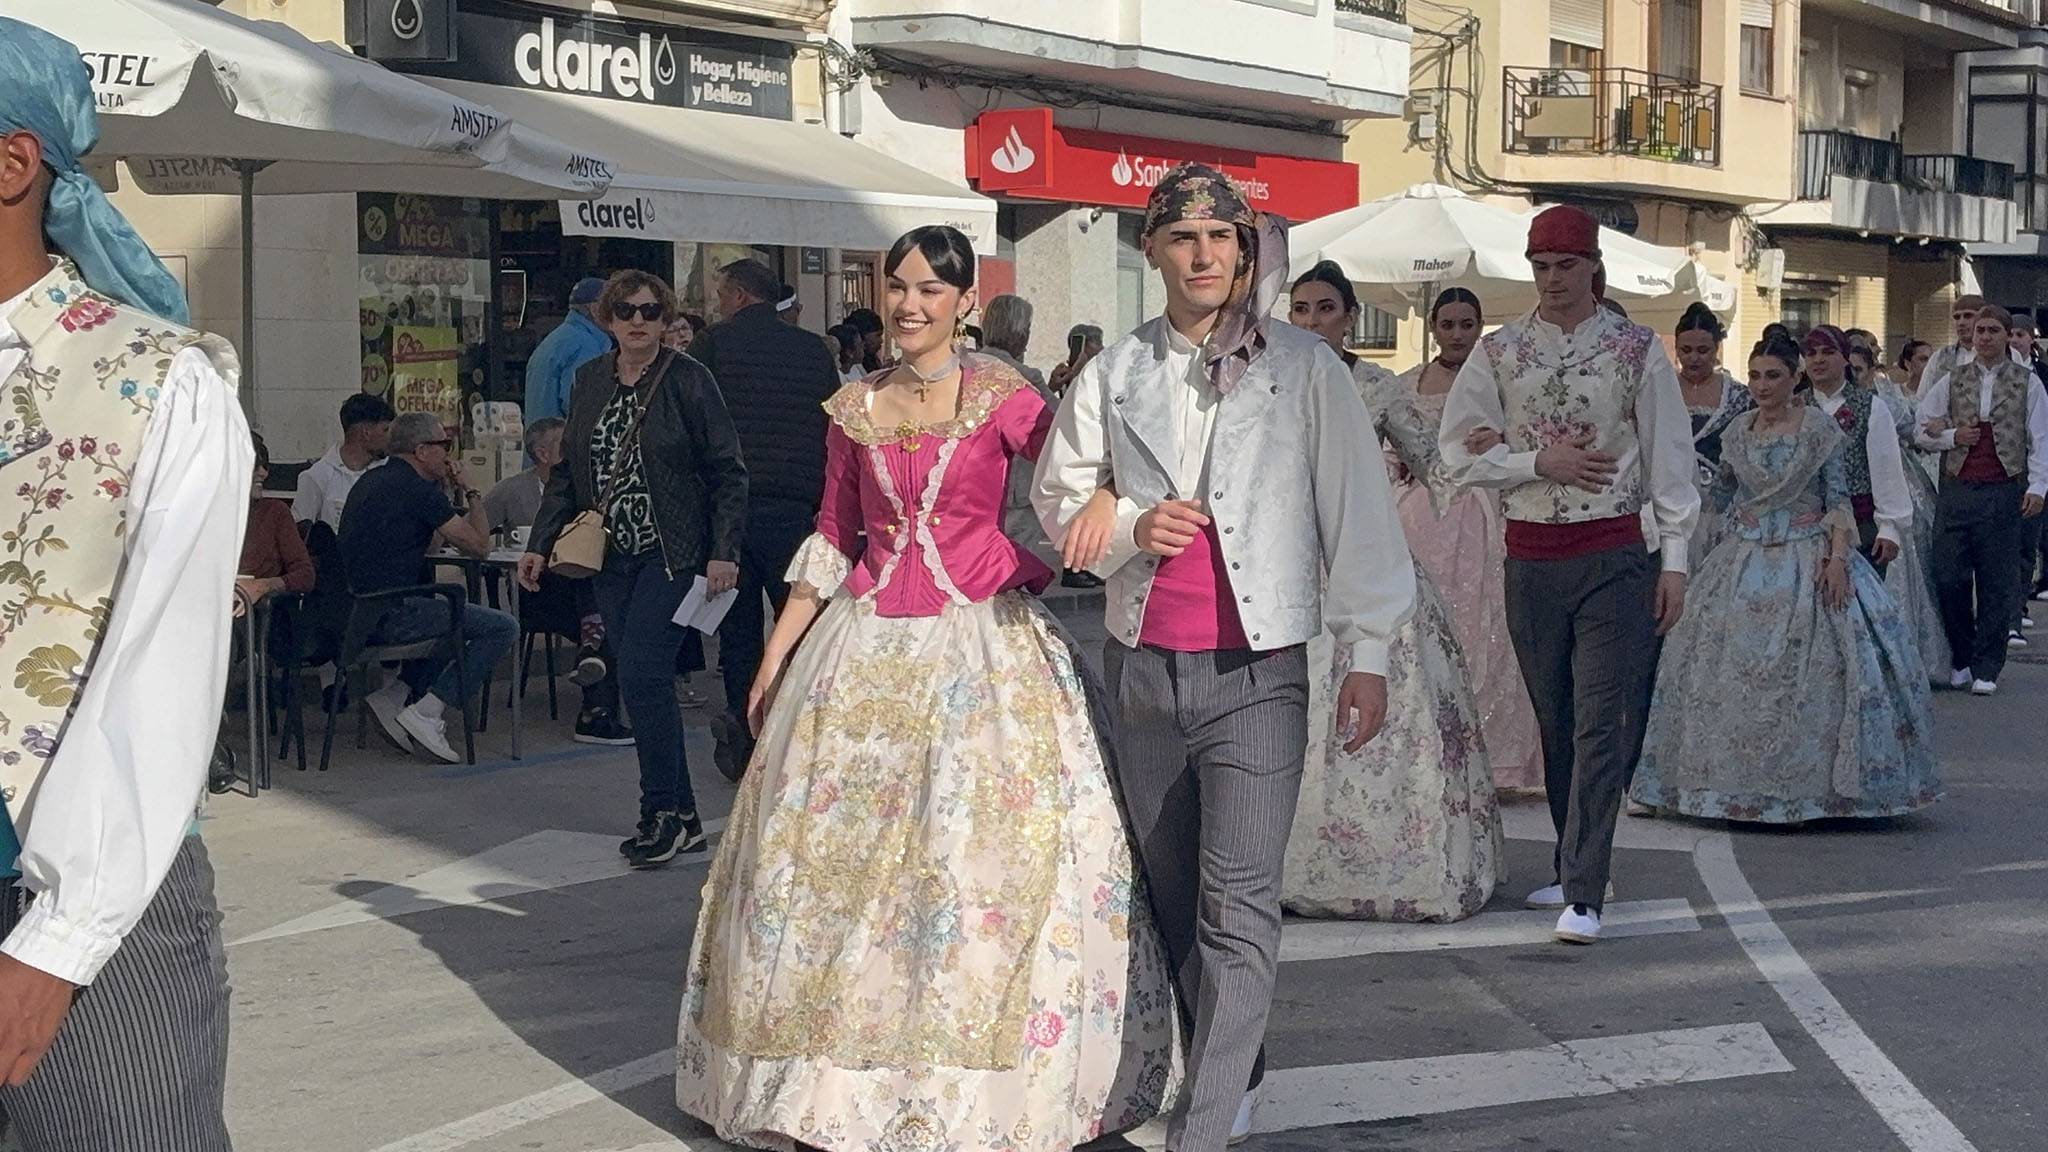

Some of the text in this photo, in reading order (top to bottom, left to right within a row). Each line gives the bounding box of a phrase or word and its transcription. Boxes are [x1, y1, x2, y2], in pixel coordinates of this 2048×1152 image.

[514, 17, 655, 101] clarel
[690, 53, 788, 88] Hogar, Higiene
[692, 81, 753, 107] y Belleza
[564, 153, 614, 180] AMSTEL
[577, 197, 645, 231] clarel
[400, 223, 455, 249] MEGA
[406, 377, 445, 394] MEGA
[397, 395, 456, 412] OFERTAS
